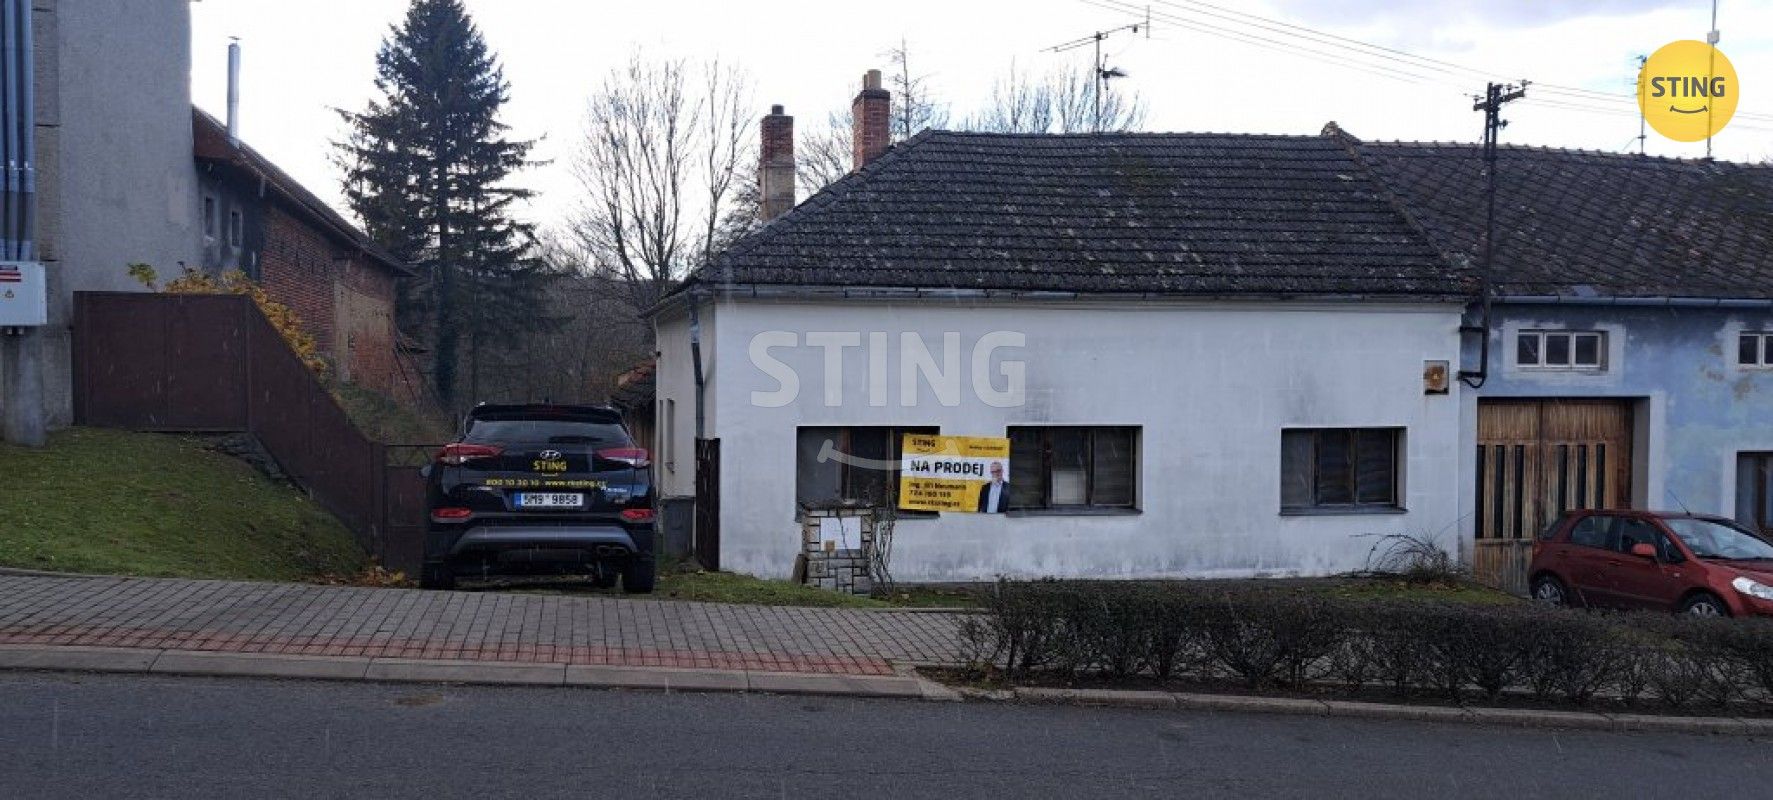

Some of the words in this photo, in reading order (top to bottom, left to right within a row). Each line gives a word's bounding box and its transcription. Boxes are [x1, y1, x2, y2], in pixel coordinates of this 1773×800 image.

[912, 438, 935, 448] STING
[533, 460, 567, 472] STING
[911, 461, 929, 471] NA
[935, 462, 984, 476] PRODEJ
